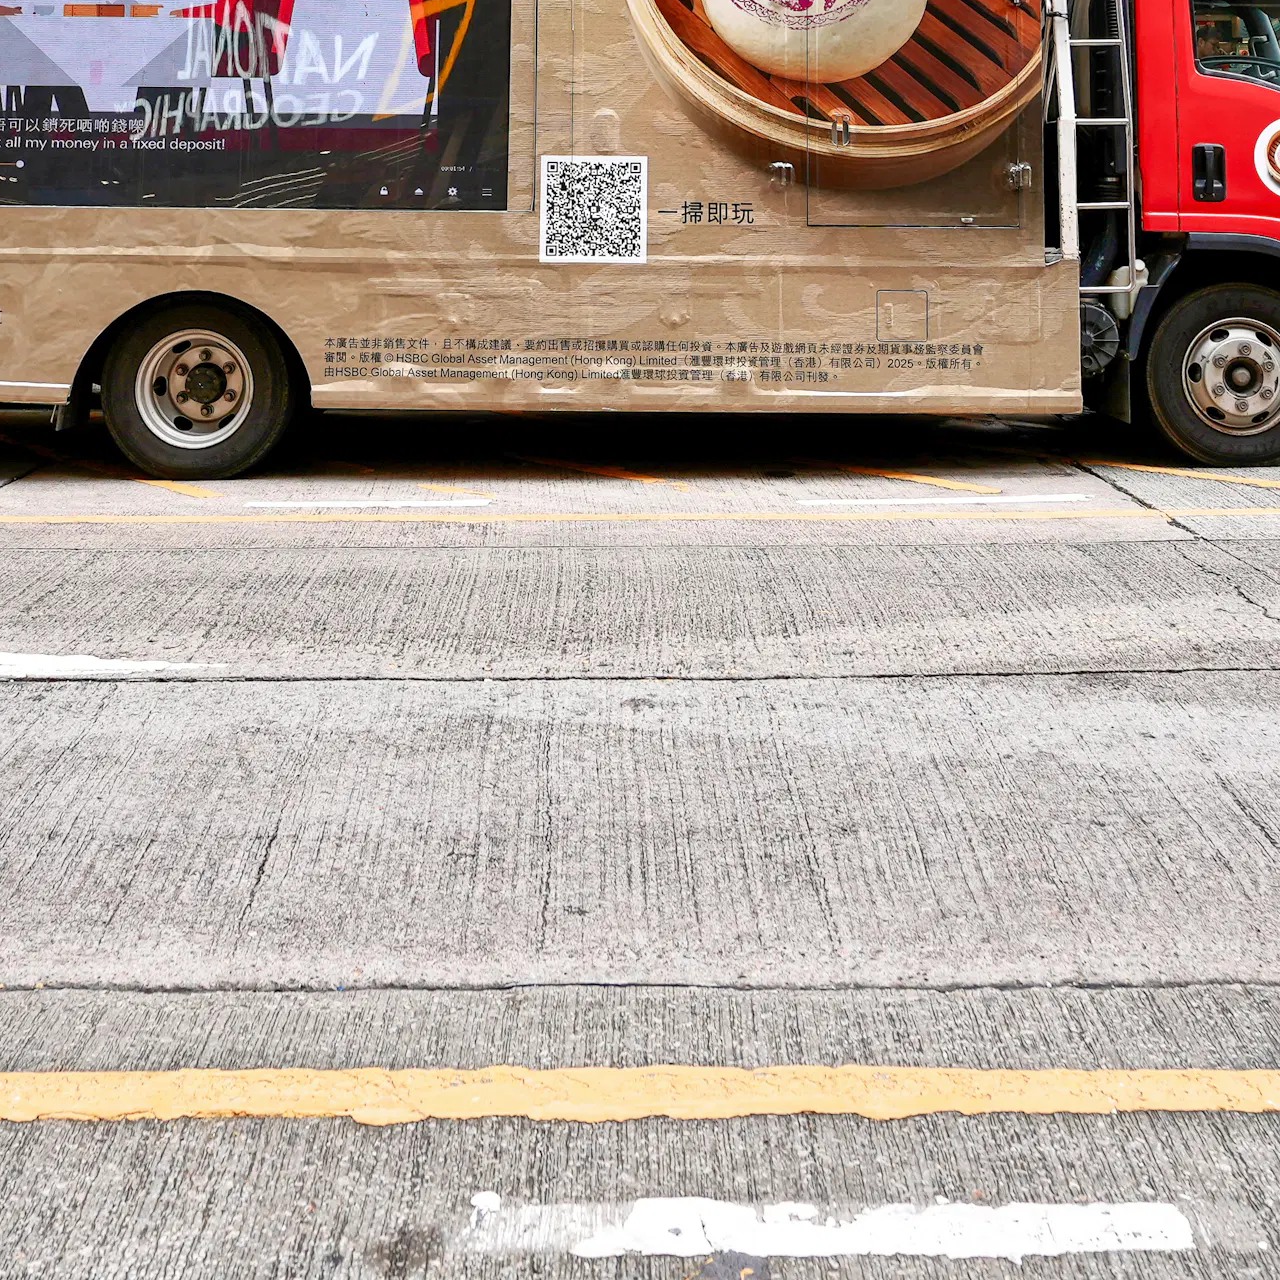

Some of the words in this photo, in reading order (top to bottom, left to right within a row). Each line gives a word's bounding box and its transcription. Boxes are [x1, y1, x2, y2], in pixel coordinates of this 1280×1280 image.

[5, 136, 21, 148] all
[25, 140, 47, 151] my
[51, 140, 99, 152] money
[103, 138, 116, 150] in
[119, 140, 128, 150] a
[131, 138, 166, 150] fixed
[169, 138, 226, 152] deposit!
[657, 200, 755, 225] 一掃即玩
[396, 353, 429, 364] HSBC
[431, 353, 465, 364] Global
[468, 354, 498, 365] Asset
[499, 354, 568, 367] Management
[570, 354, 604, 367] (Hong
[605, 354, 637, 368] Kong)
[370, 367, 404, 378] Global
[408, 368, 437, 379] Asset
[440, 369, 509, 381] Management
[511, 369, 544, 381] (Hong
[547, 369, 579, 382] Kong)
